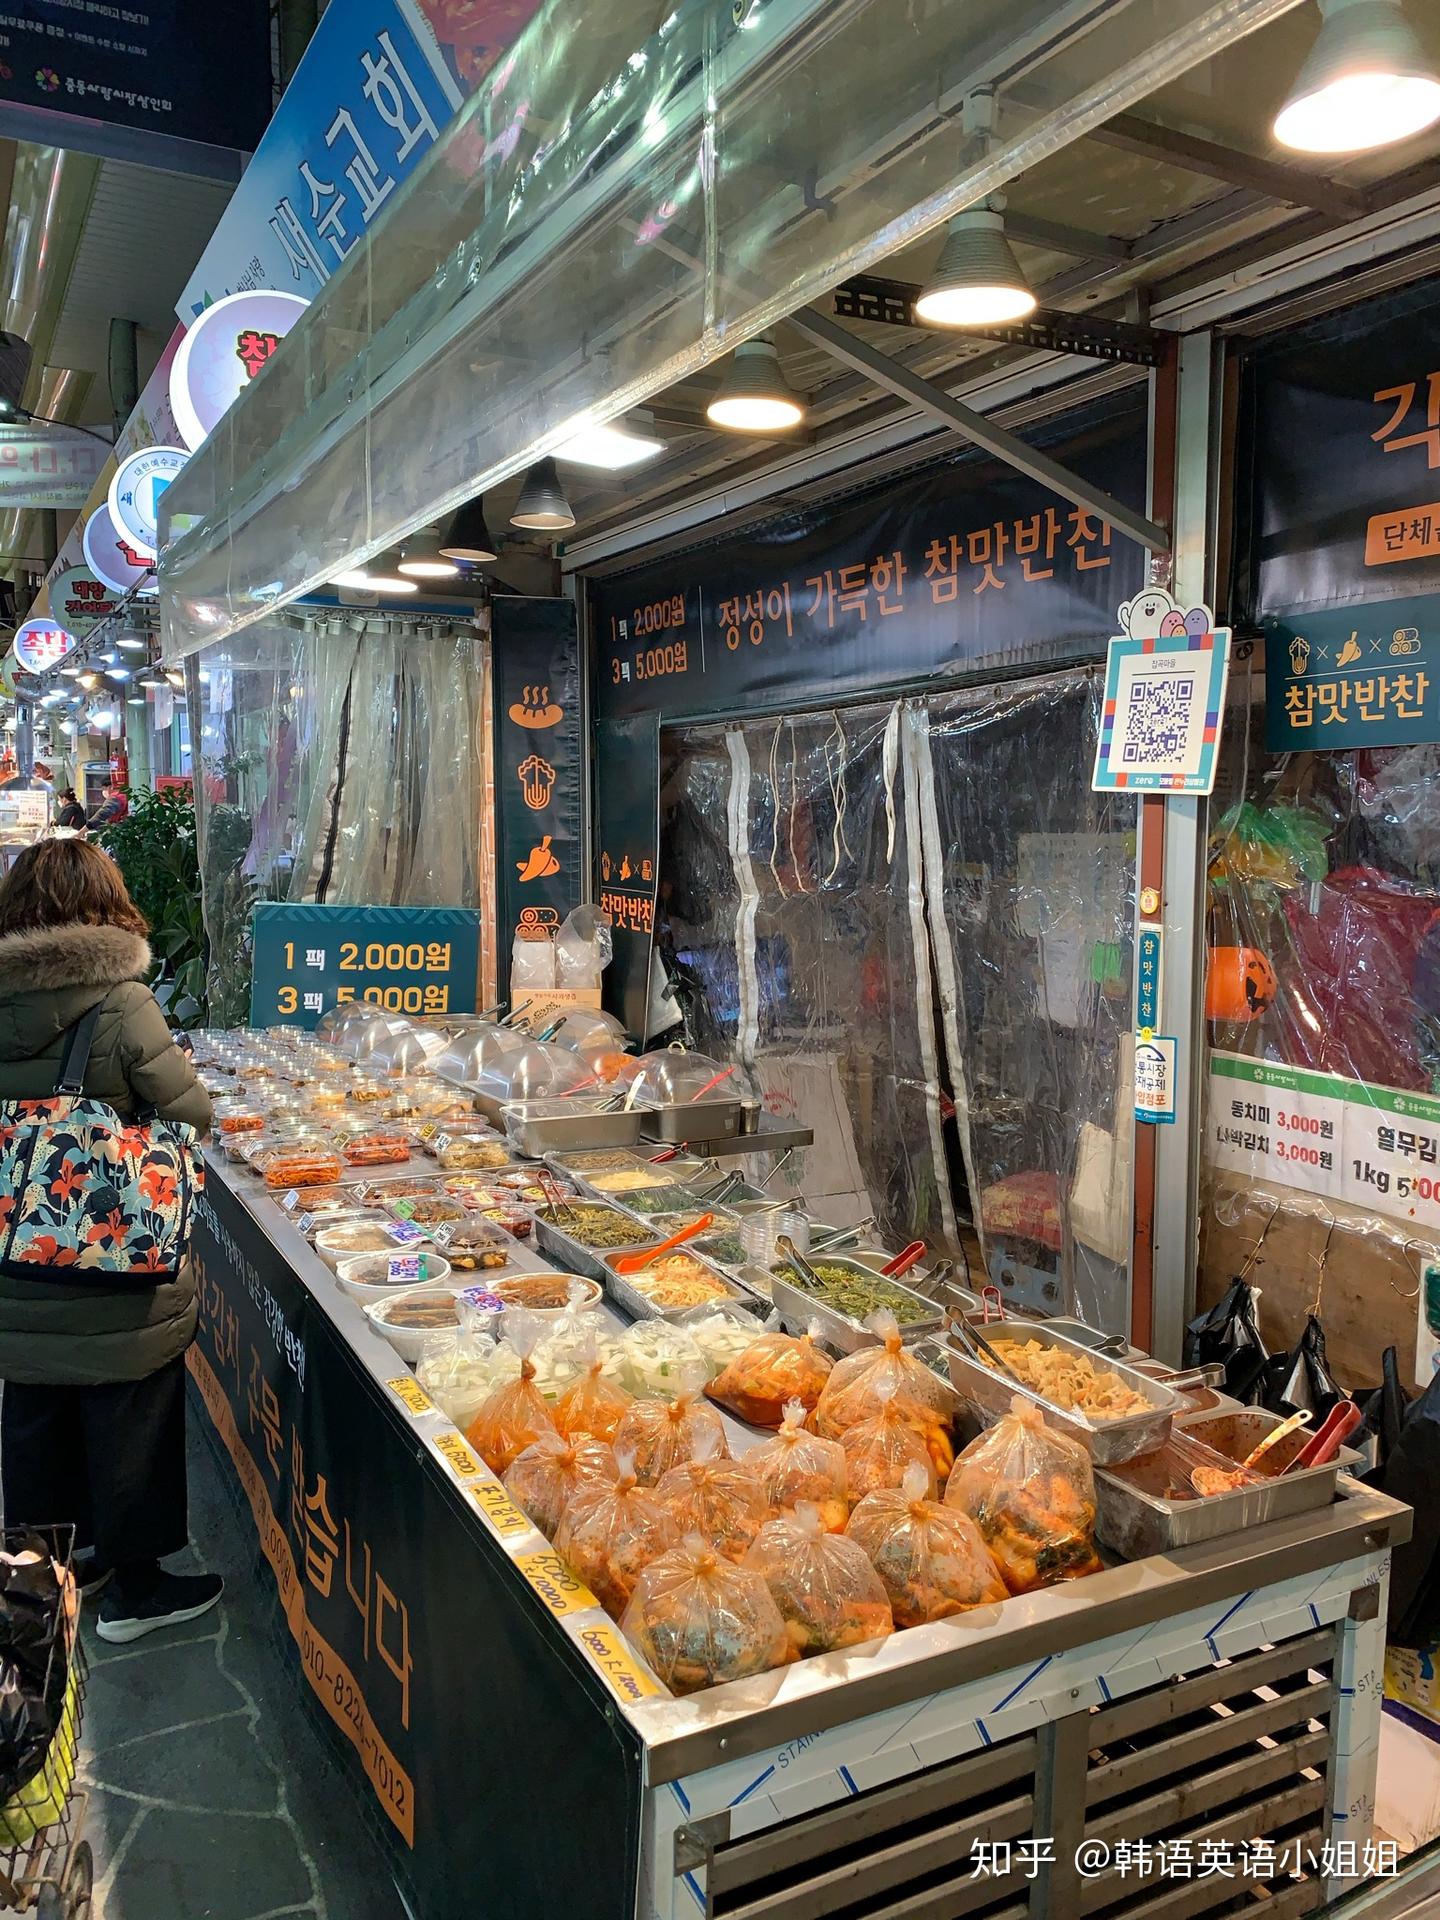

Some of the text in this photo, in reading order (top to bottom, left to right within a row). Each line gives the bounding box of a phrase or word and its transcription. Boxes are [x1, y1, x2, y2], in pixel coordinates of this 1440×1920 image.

[269, 31, 439, 285] 새순교회
[1383, 516, 1440, 551] 단체
[633, 593, 686, 636] 2,000원
[719, 582, 793, 651] 정성이
[805, 552, 905, 629] 가득한
[636, 641, 688, 680] 5,000원
[1285, 671, 1428, 728] 참맛반찬
[1134, 776, 1154, 785] zero
[283, 942, 451, 971] 1 팩 2,000원
[1138, 939, 1155, 1017] 참맛반찬
[277, 984, 449, 1014] 3 팩 5000원
[1135, 1062, 1167, 1078] 통시장
[1135, 1076, 1166, 1091] 재공제
[1136, 1091, 1166, 1106] 입점포
[1231, 1100, 1334, 1139] 동치미 3,000원
[1276, 1141, 1333, 1170] 3,000원
[1352, 1159, 1390, 1193] 1kg
[284, 1325, 306, 1393] 반찬
